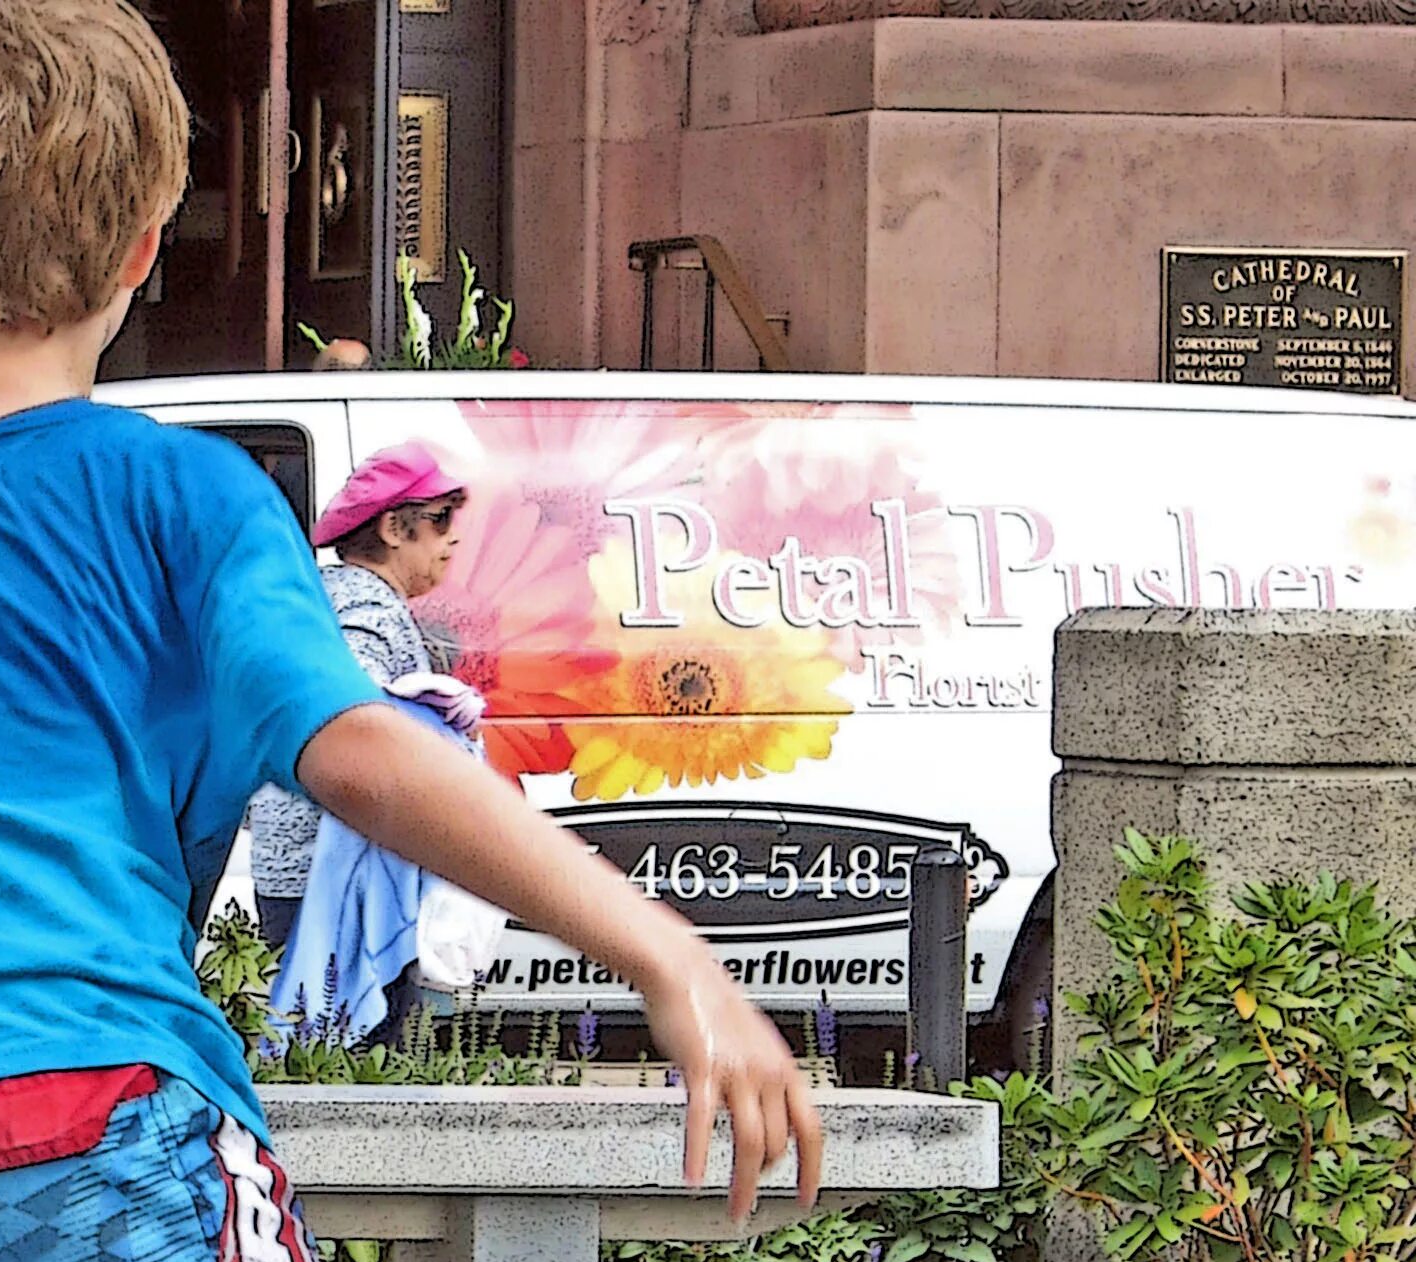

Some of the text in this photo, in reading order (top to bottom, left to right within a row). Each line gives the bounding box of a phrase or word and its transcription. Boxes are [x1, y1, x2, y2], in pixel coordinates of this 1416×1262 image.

[1212, 258, 1362, 297] CATHEDRAL
[1271, 285, 1297, 303] OF
[1180, 304, 1392, 330] SS. PETER AND PAUL
[1276, 338, 1350, 353] SEPTEMBER
[1174, 353, 1246, 368] DEDICATED
[1274, 355, 1342, 369] NOVEMBER
[1174, 369, 1242, 383] ENLARGED
[1281, 371, 1340, 385] OCTOBER
[603, 496, 1366, 629] Petal Pusher
[859, 646, 1042, 708] Florist
